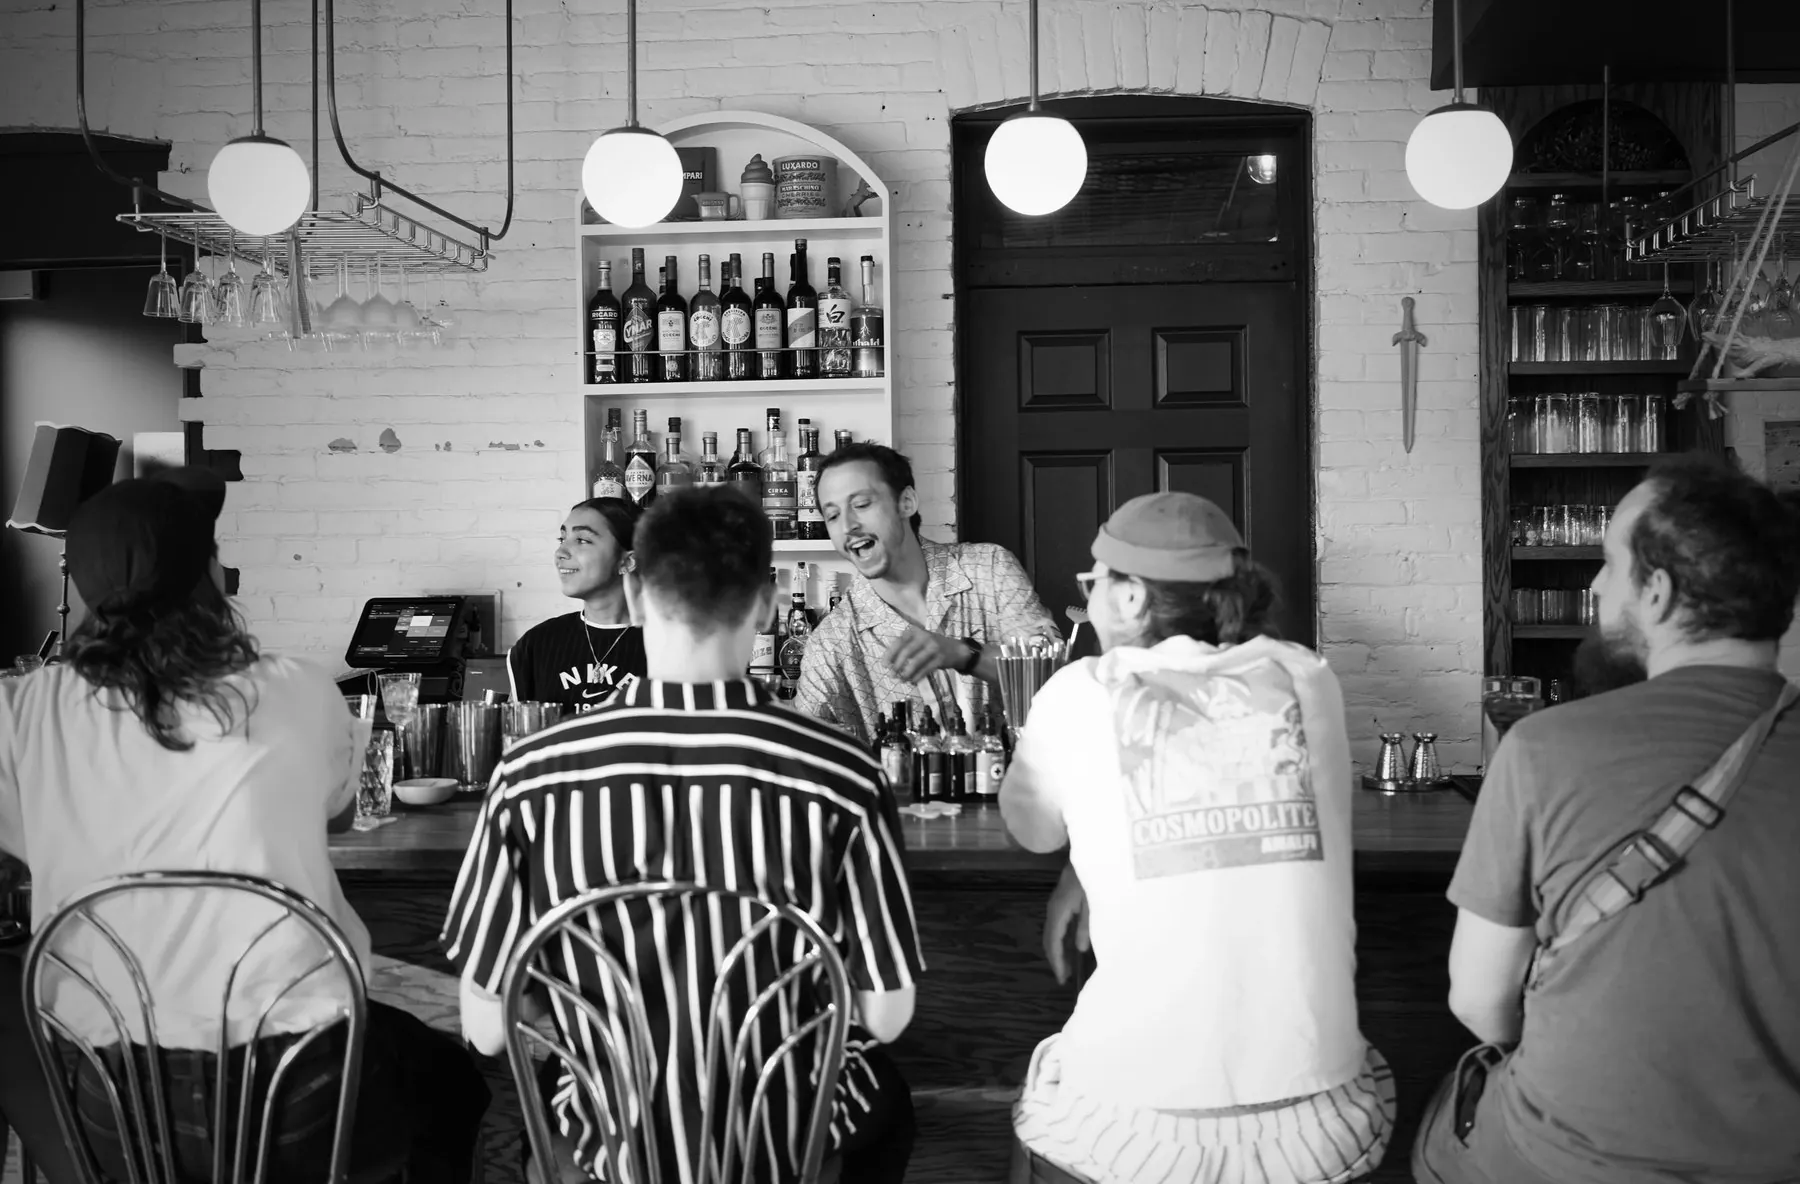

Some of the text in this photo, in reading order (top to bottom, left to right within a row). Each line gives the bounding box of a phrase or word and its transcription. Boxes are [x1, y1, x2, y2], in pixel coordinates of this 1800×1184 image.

[781, 161, 818, 170] LUXARDO
[826, 303, 845, 324] 白
[623, 319, 653, 343] CYNAR
[626, 474, 653, 482] AVERNA
[559, 663, 637, 690] NIKE
[1133, 803, 1317, 846] COSMOPOLITE
